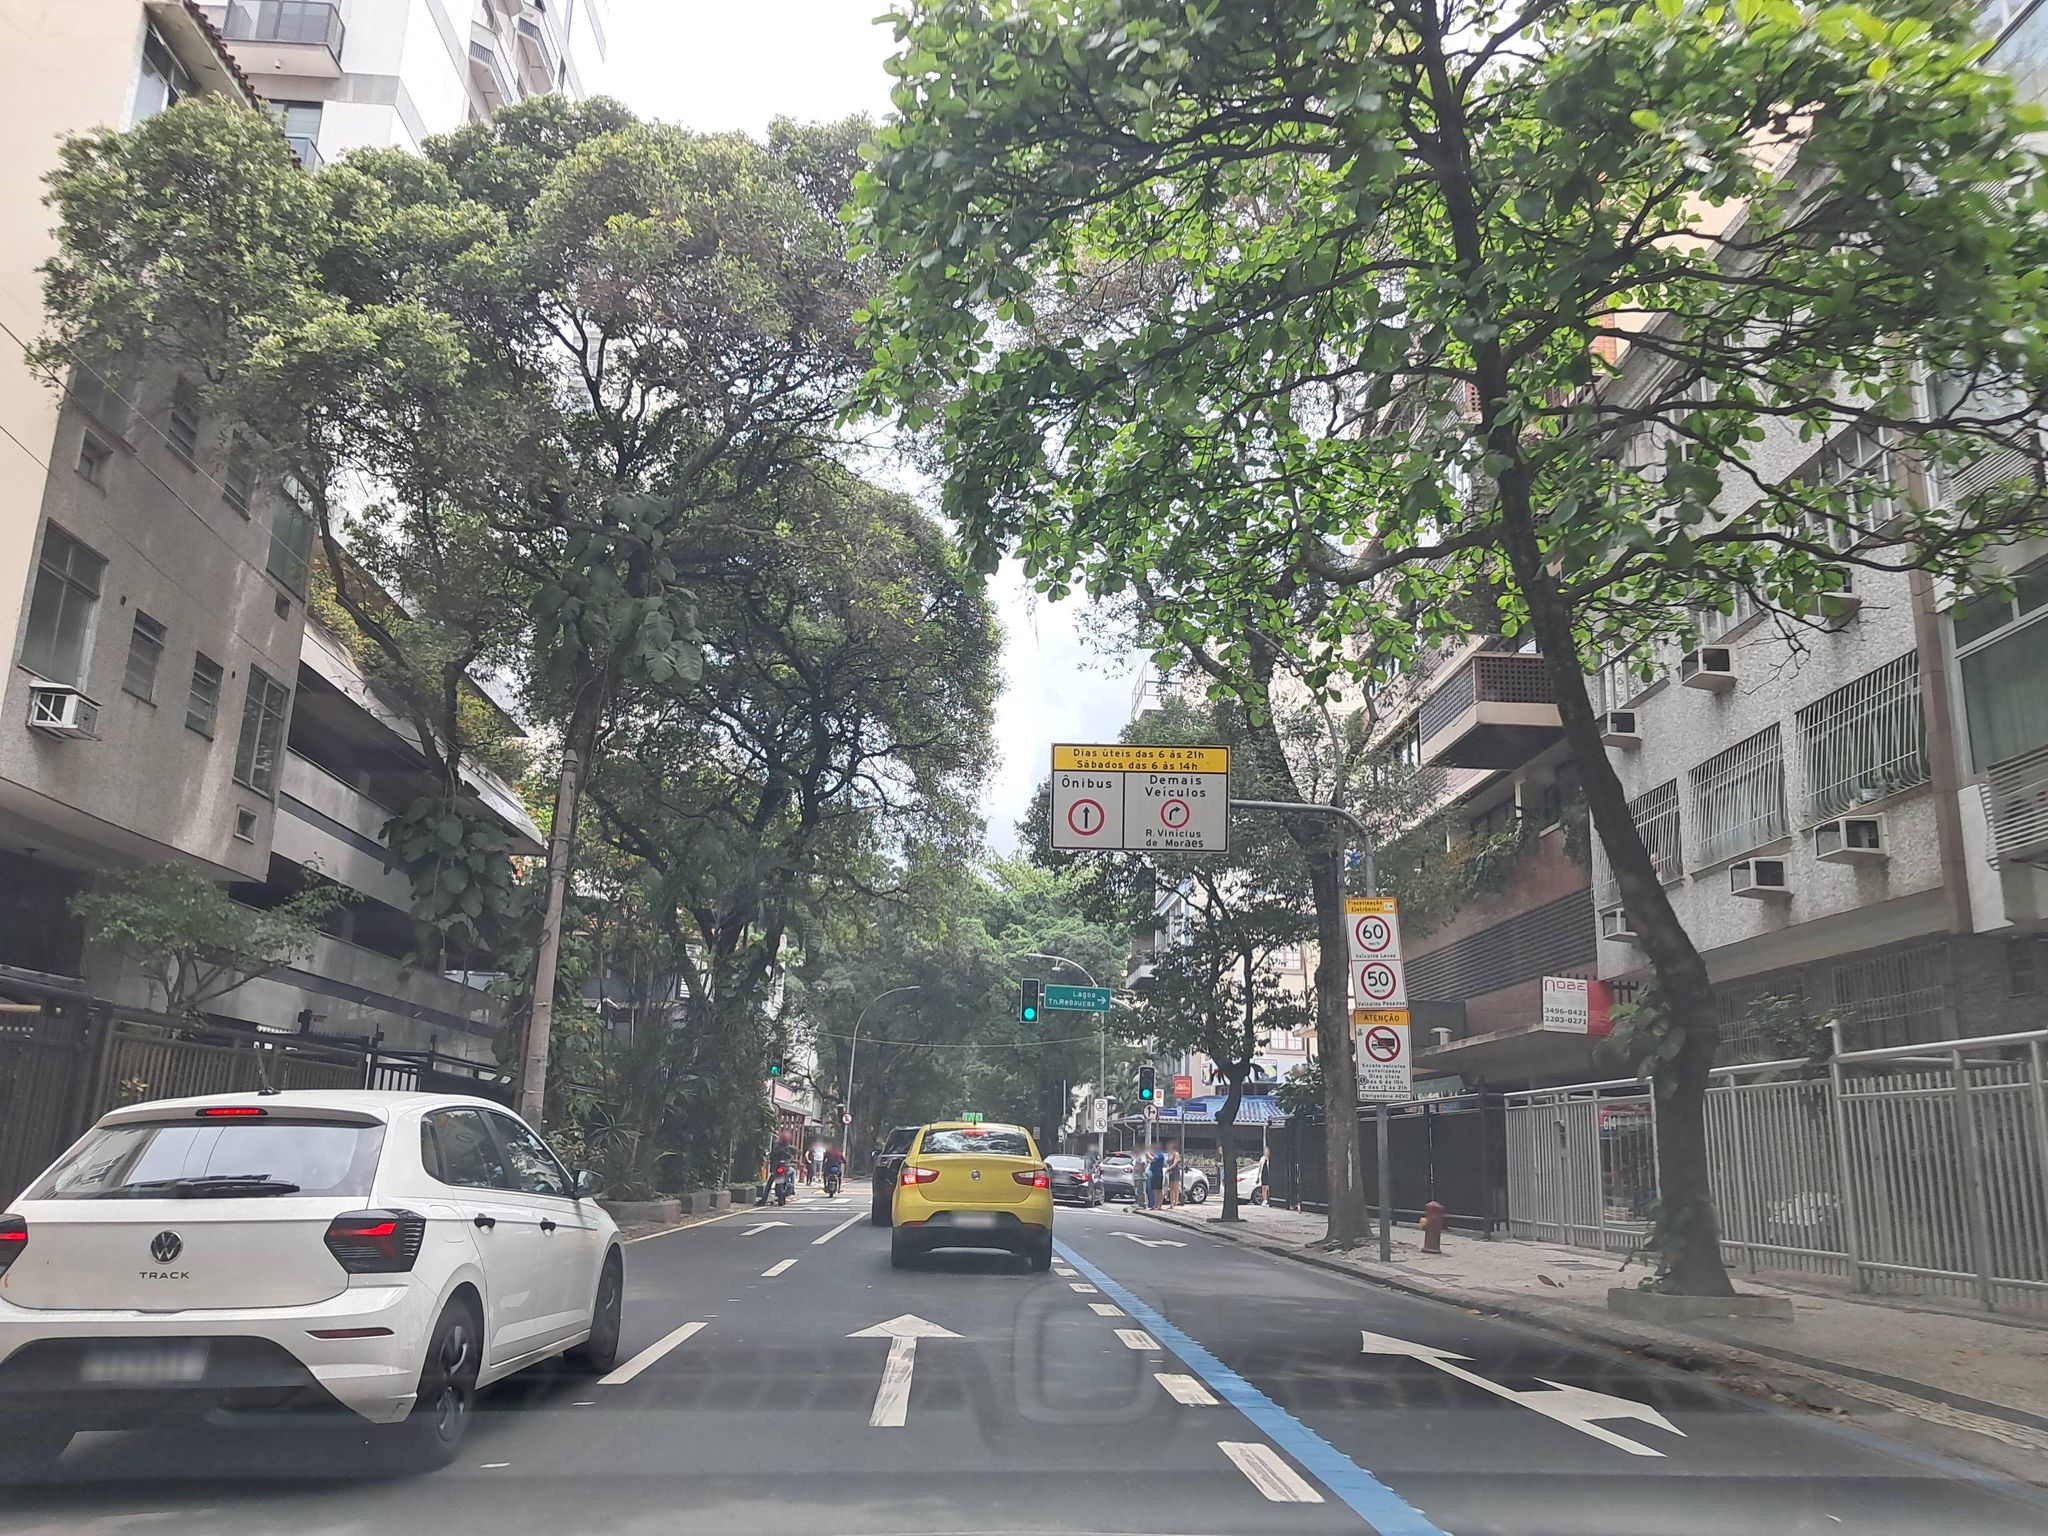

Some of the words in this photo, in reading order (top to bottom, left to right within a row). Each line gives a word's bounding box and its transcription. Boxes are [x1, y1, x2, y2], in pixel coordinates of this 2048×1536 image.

[1073, 748, 1098, 757] Dias
[1102, 748, 1131, 758] úteis
[1135, 749, 1154, 758] das
[1158, 750, 1165, 759] 6
[1169, 749, 1184, 759] às
[1187, 751, 1205, 760] 21h
[1076, 759, 1124, 769] Sábados
[1128, 760, 1147, 770] das
[1151, 761, 1158, 770] 6
[1162, 760, 1175, 770] às
[1179, 761, 1199, 771] 14h
[1061, 774, 1113, 789] Ônibus
[1149, 774, 1202, 786] Demais
[1144, 786, 1207, 799] Veículos
[1145, 828, 1155, 838] R.
[1145, 838, 1158, 848] de
[1164, 838, 1204, 849] Moraes
[1362, 923, 1384, 940] 60
[1367, 971, 1389, 987] 50
[1072, 990, 1096, 999] Lagoa
[1363, 1013, 1400, 1023] ATENÇÃO
[139, 1271, 190, 1280] TRACK
